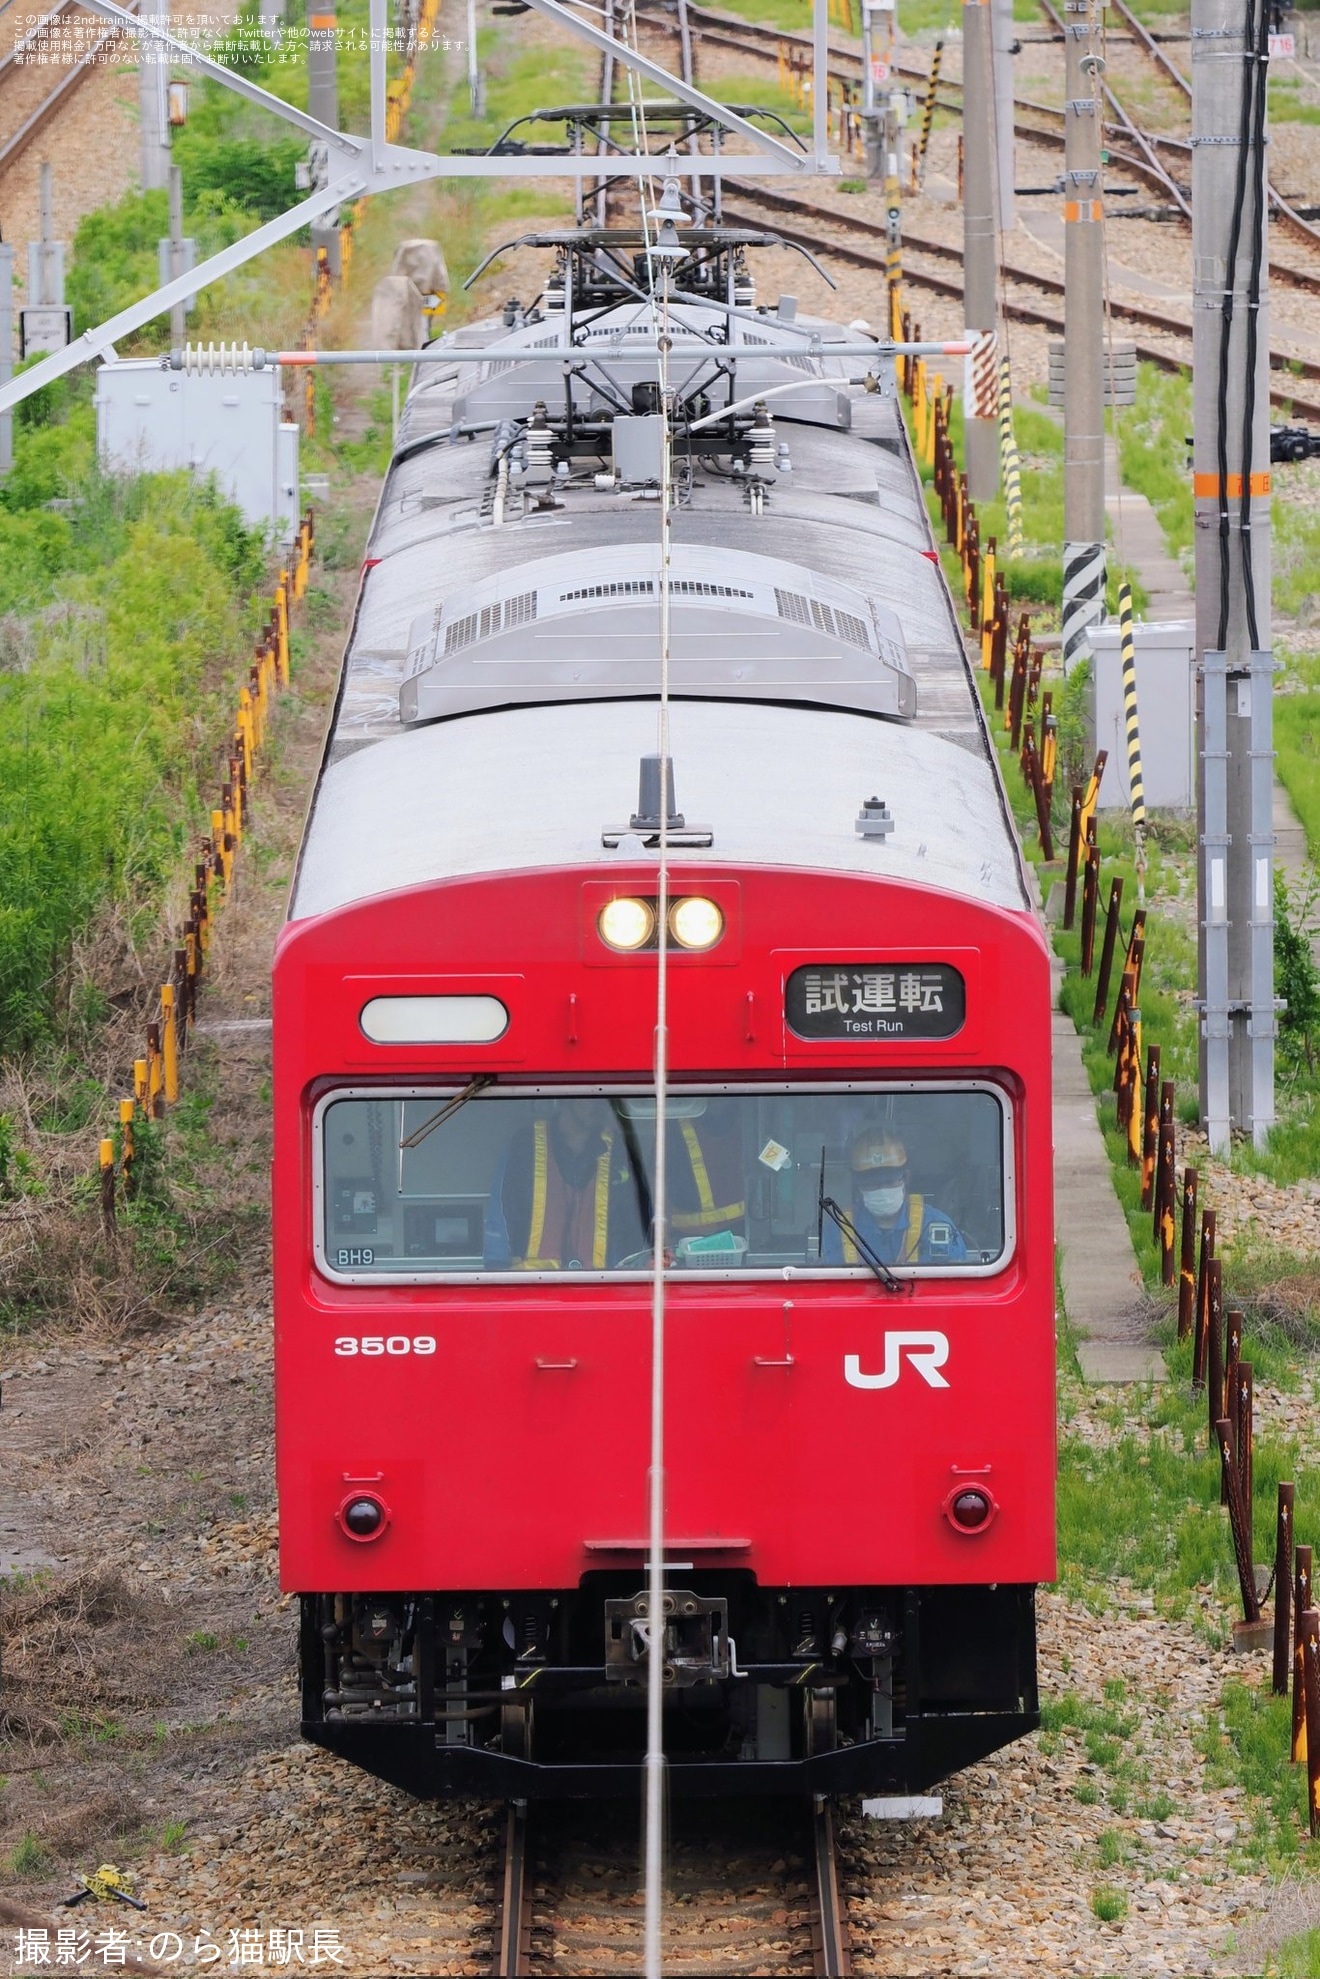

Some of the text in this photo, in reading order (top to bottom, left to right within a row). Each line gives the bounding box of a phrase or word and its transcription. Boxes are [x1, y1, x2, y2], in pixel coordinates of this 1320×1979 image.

[805, 973, 943, 1014] 試運転
[843, 1020, 903, 1032] Test Run
[338, 1249, 373, 1265] BH9
[334, 1336, 436, 1356] 3509
[844, 1331, 951, 1390] JR
